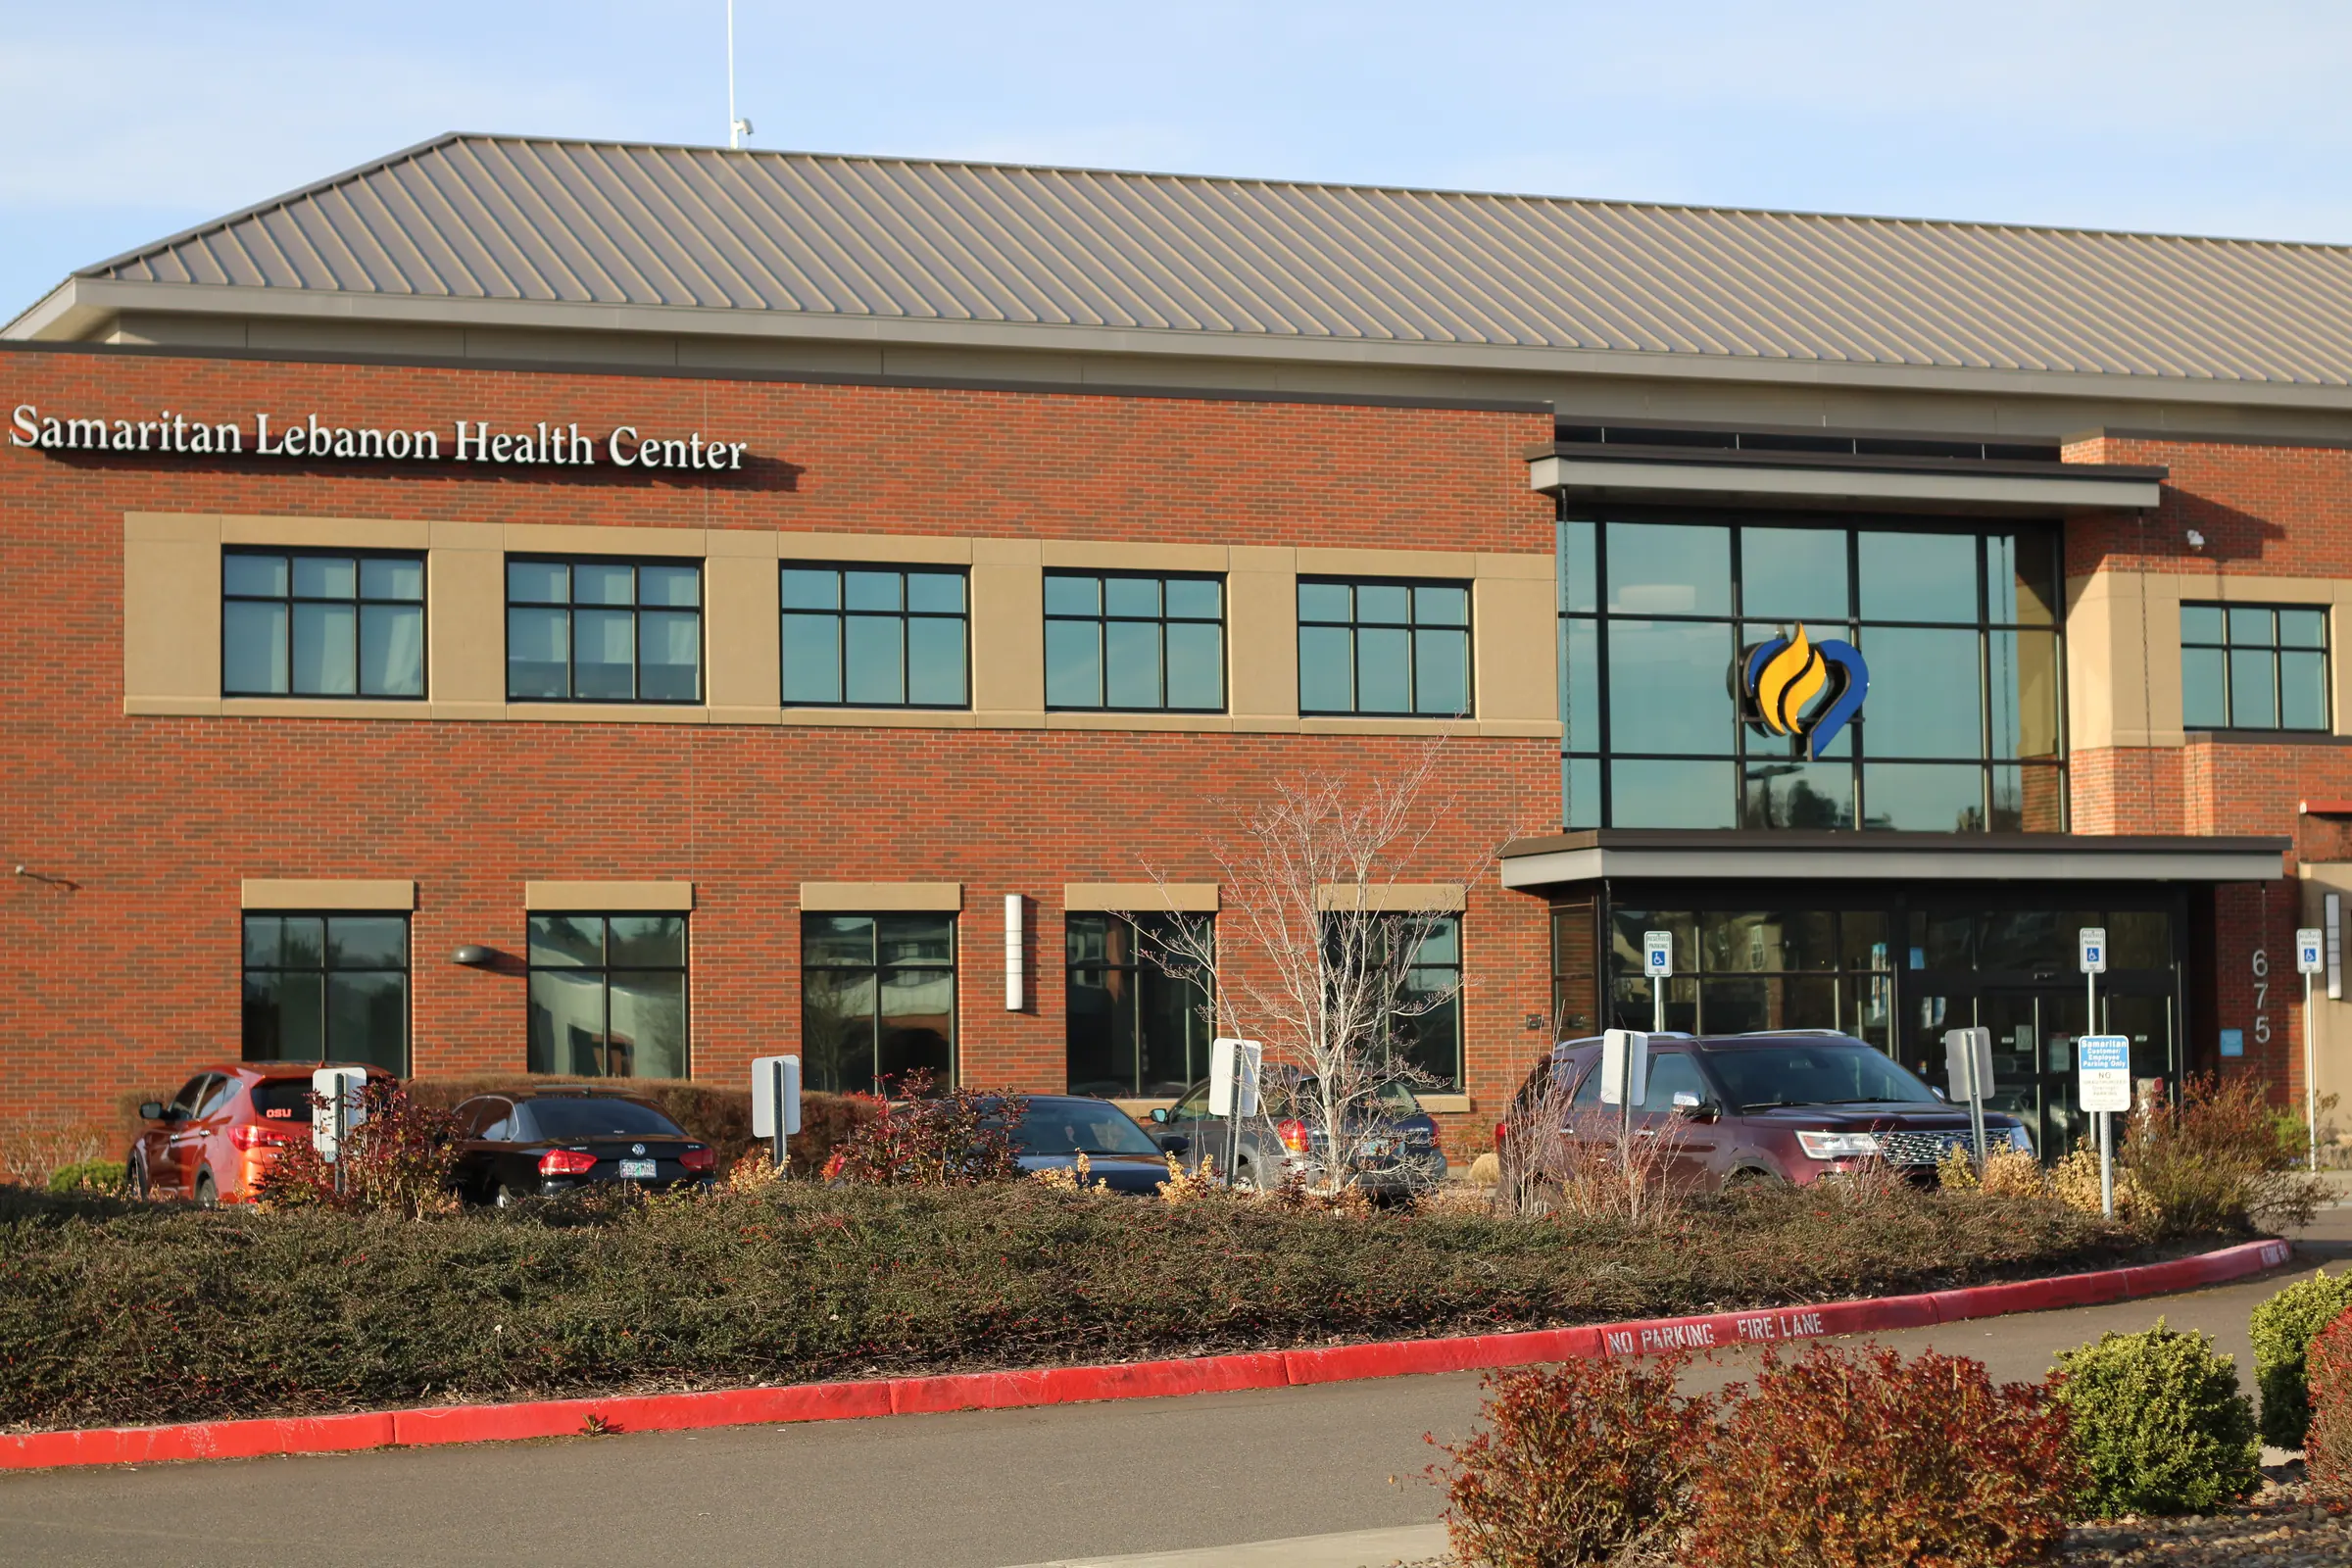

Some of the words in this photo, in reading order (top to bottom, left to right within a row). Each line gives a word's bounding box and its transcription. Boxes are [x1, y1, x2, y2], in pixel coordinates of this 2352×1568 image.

[10, 404, 243, 454] Samaritan
[256, 412, 440, 460] Lebanon
[454, 419, 595, 465] Health
[608, 425, 748, 470] Center
[2252, 949, 2271, 1044] 675
[2081, 1039, 2127, 1048] Samaritan
[267, 1108, 292, 1118] OSU
[1607, 1331, 1635, 1354] NO
[1641, 1323, 1715, 1351] PARKING
[1737, 1316, 1776, 1341] FIRE
[1781, 1312, 1824, 1338] LANE
